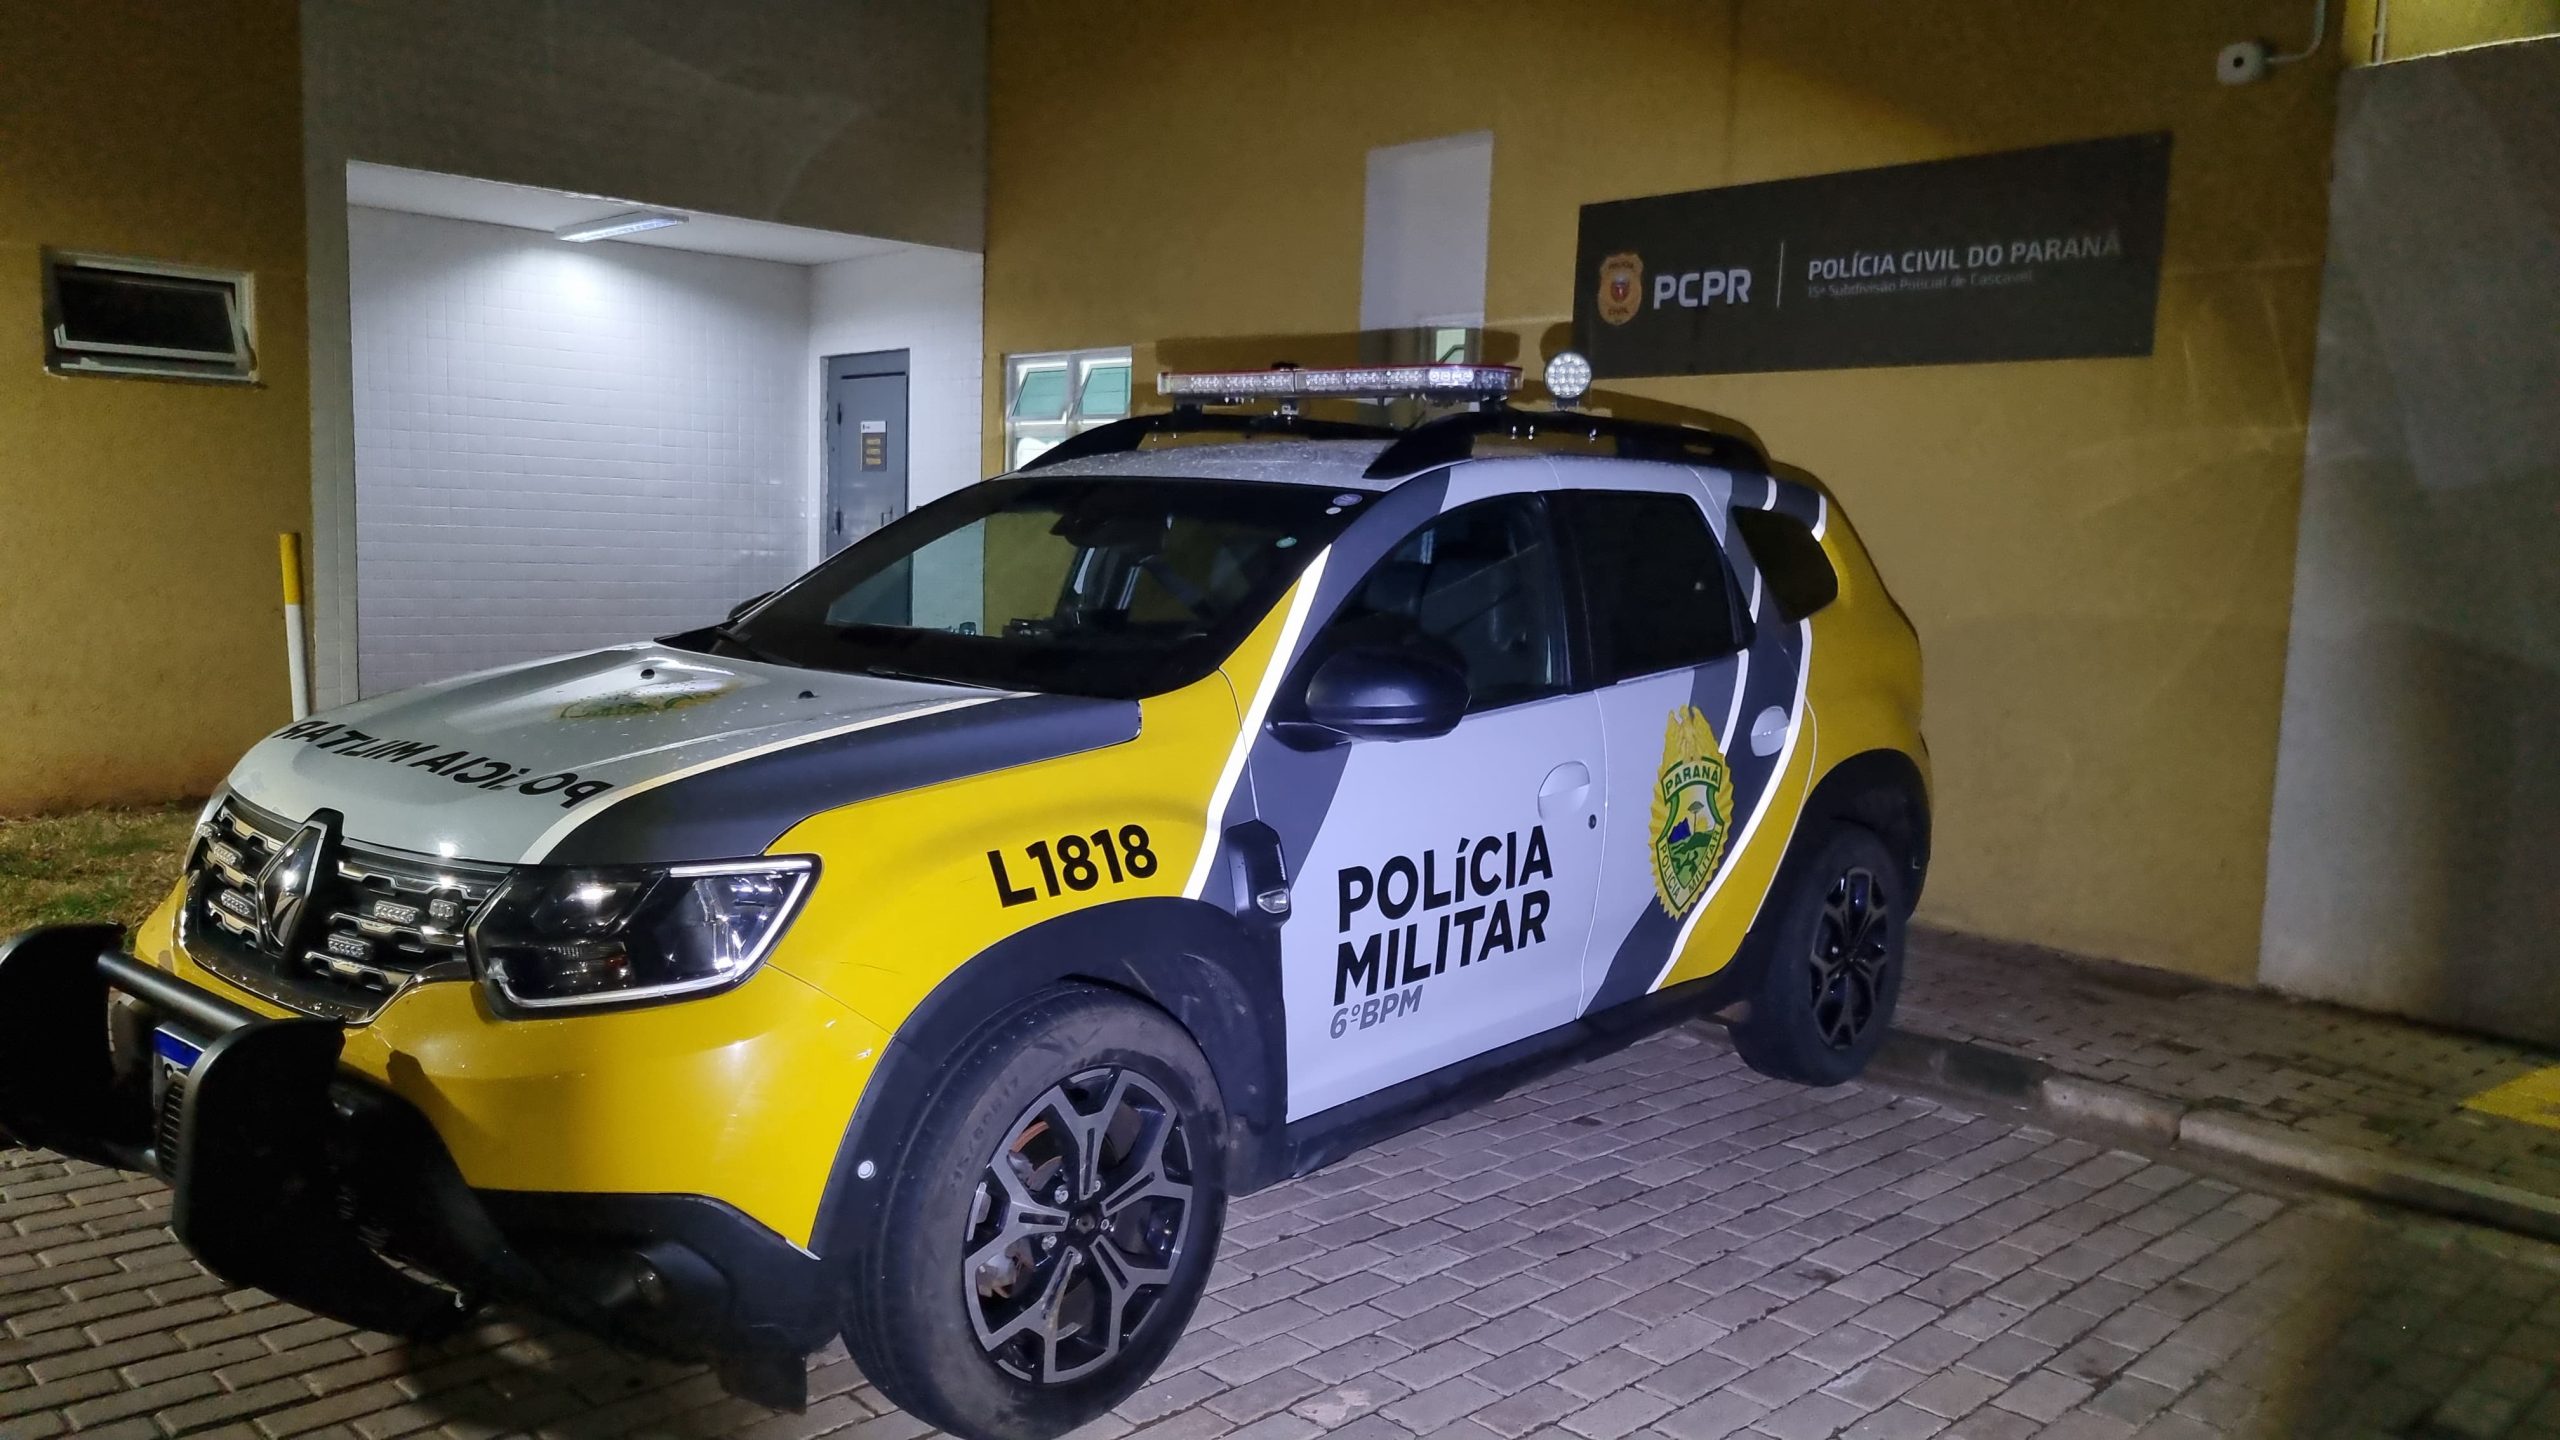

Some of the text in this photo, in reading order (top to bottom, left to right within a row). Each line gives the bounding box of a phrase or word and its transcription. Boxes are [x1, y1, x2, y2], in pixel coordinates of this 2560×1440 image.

[1807, 229, 2121, 281] POLÍCIA CIVIL DO PARANÁ
[1653, 268, 1751, 310] PCPR
[1665, 765, 1720, 796] PARANÁ
[987, 824, 1158, 909] L1818
[1688, 829, 1720, 894] MILITAR
[1333, 889, 1551, 1007] MILITAR
